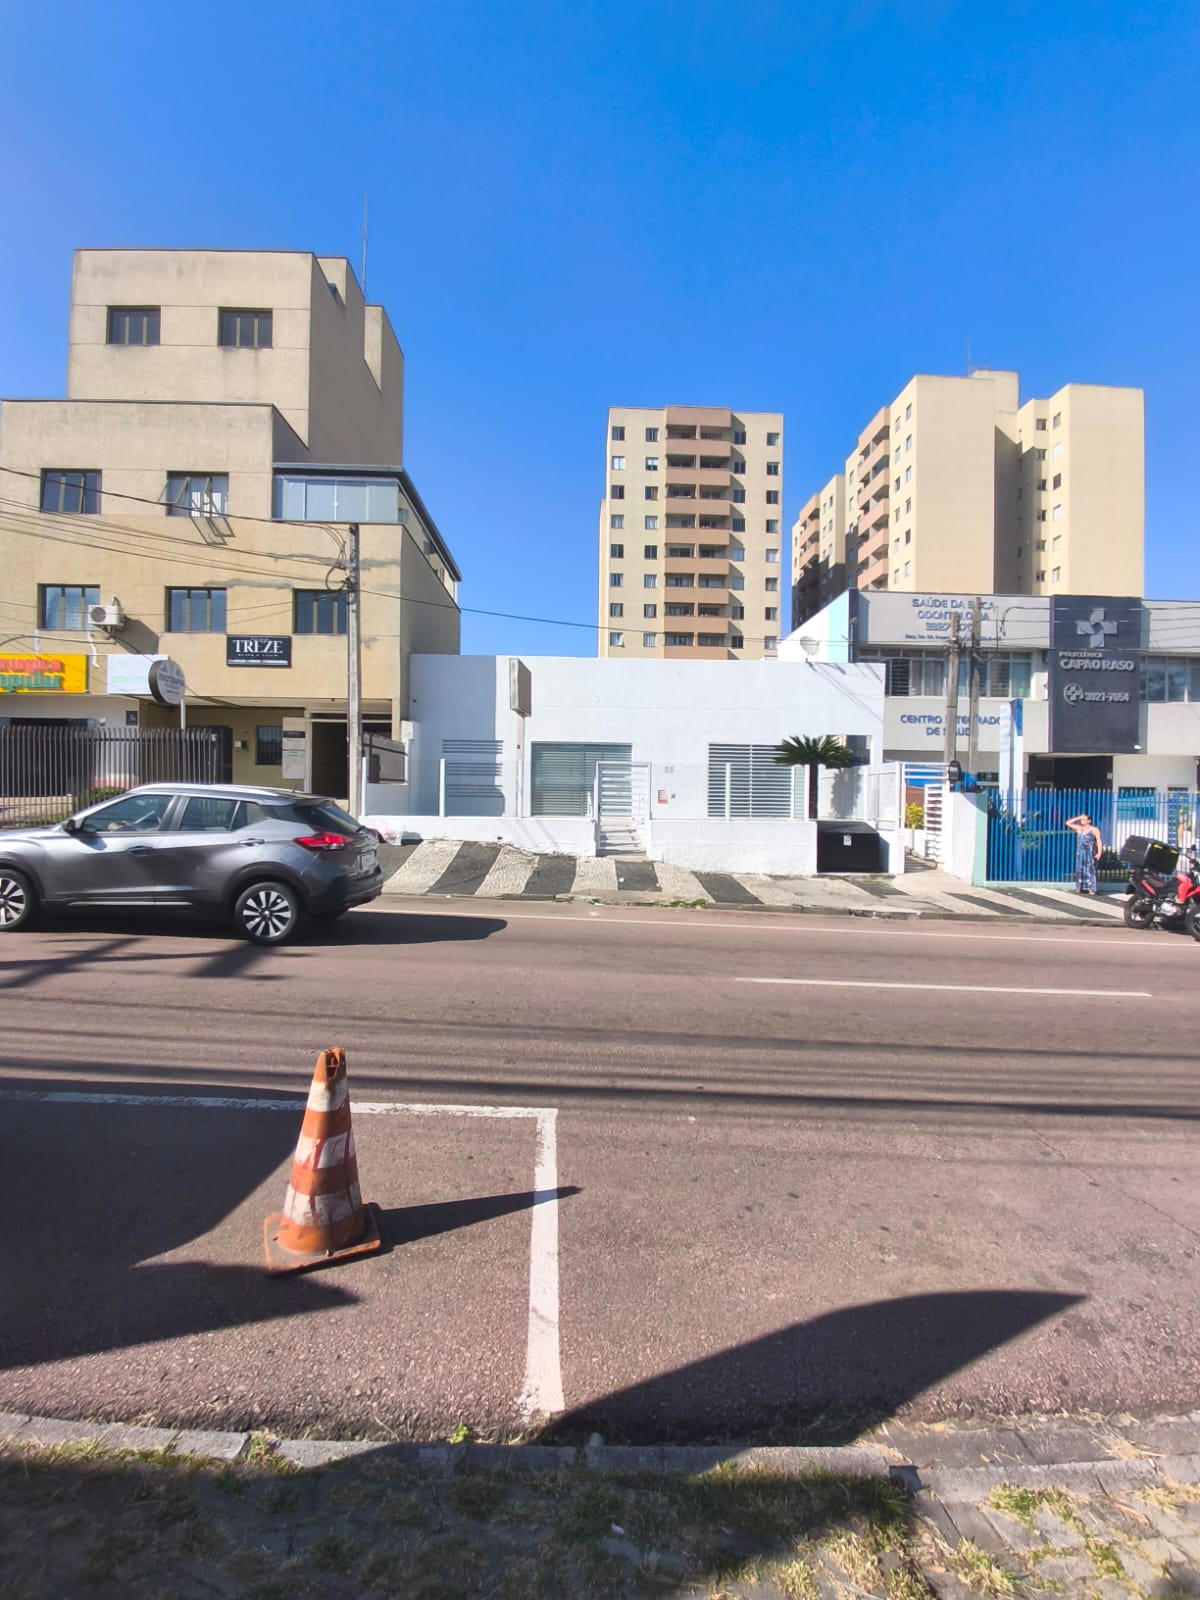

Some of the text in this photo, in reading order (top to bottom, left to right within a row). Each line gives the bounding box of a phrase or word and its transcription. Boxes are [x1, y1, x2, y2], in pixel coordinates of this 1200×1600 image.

[912, 597, 948, 608] SAÚDE
[951, 600, 965, 608] DA
[233, 639, 284, 654] TREZE
[1102, 660, 1134, 671] RASO
[900, 714, 942, 724] CENTRO
[926, 727, 940, 736] DE
